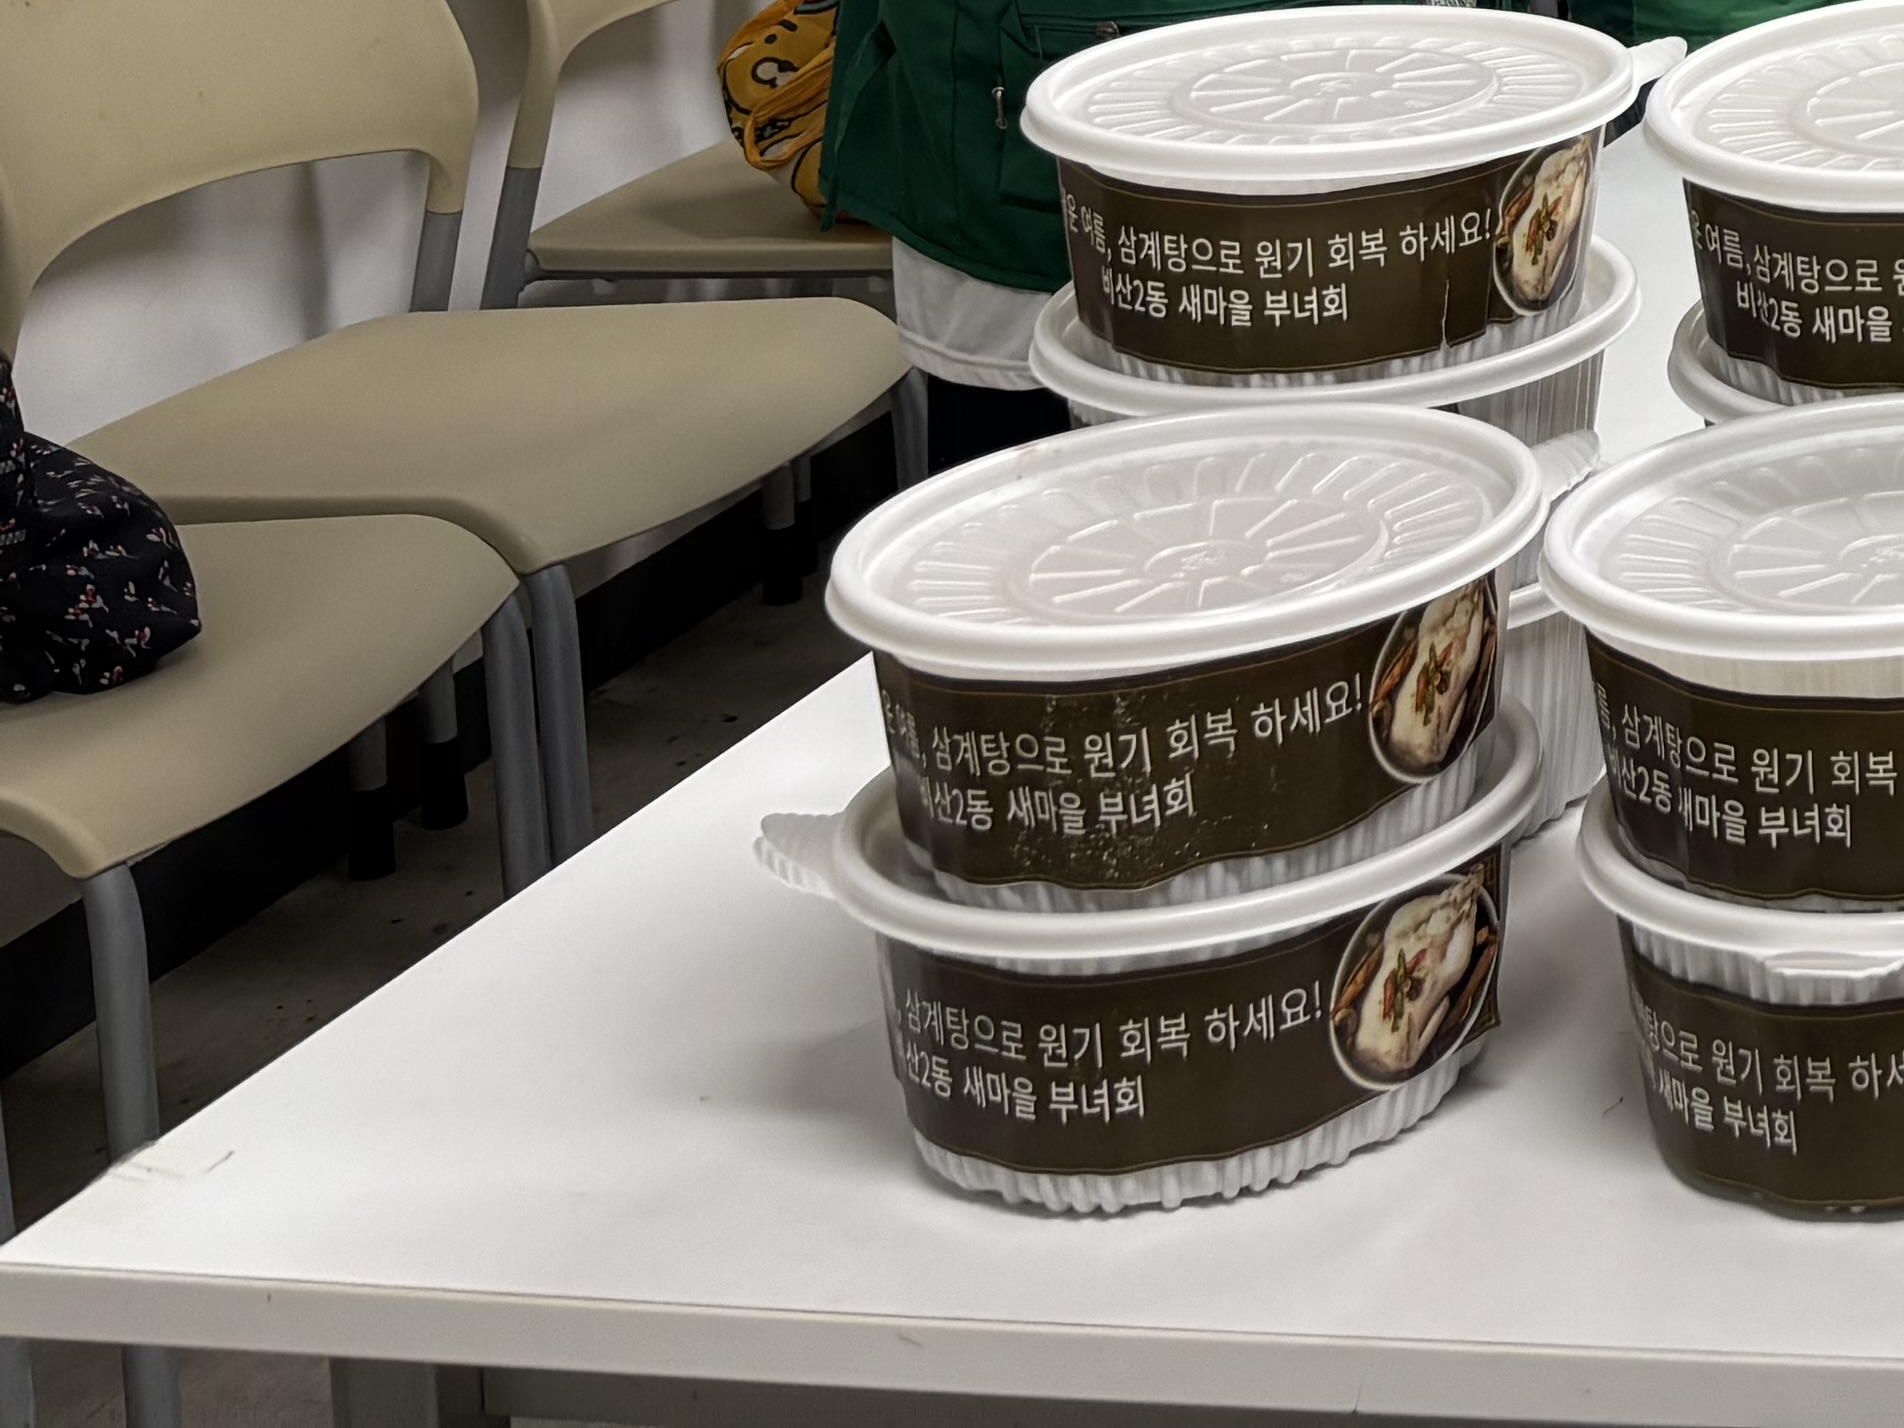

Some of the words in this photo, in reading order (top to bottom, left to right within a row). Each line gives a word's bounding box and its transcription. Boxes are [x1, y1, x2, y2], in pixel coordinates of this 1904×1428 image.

[1117, 225, 1244, 274] 삼계탕으로
[1254, 237, 1314, 278] 원기
[1327, 228, 1388, 272] 회복
[1399, 207, 1491, 261] 하세요!
[1704, 224, 1751, 276] 여름,
[1752, 245, 1883, 295] 삼계탕으로
[1101, 267, 1169, 318] 비산2동
[1179, 285, 1253, 327] 새마을
[1263, 283, 1348, 326] 부녀회
[1736, 280, 1802, 337] 비산2동
[1812, 305, 1893, 343] 새마을
[931, 726, 1072, 778] 삼계탕으로
[1084, 727, 1152, 778] 원기
[1166, 708, 1238, 761] 회복
[1250, 672, 1363, 745] 하세요!
[1621, 703, 1739, 785] 삼계탕으로
[1751, 747, 1814, 795] 원기
[1830, 749, 1898, 797] 회복
[1007, 785, 1086, 836] 새마을
[1098, 774, 1197, 834] 부녀회
[1678, 785, 1747, 845] 새마을
[1759, 803, 1852, 849] 부녀회
[905, 988, 1027, 1063] 삼계탕으로
[1038, 1022, 1103, 1069] 원기
[1119, 1012, 1191, 1064] 회복
[1204, 980, 1322, 1052] 하세요!
[962, 1066, 1038, 1121] 새마을
[1048, 1075, 1146, 1124] 부녀회
[1712, 1039, 1763, 1096] 원기
[1773, 1054, 1836, 1105] 회복
[1658, 1068, 1714, 1133] 새마을
[1723, 1095, 1798, 1156] 부녀회
